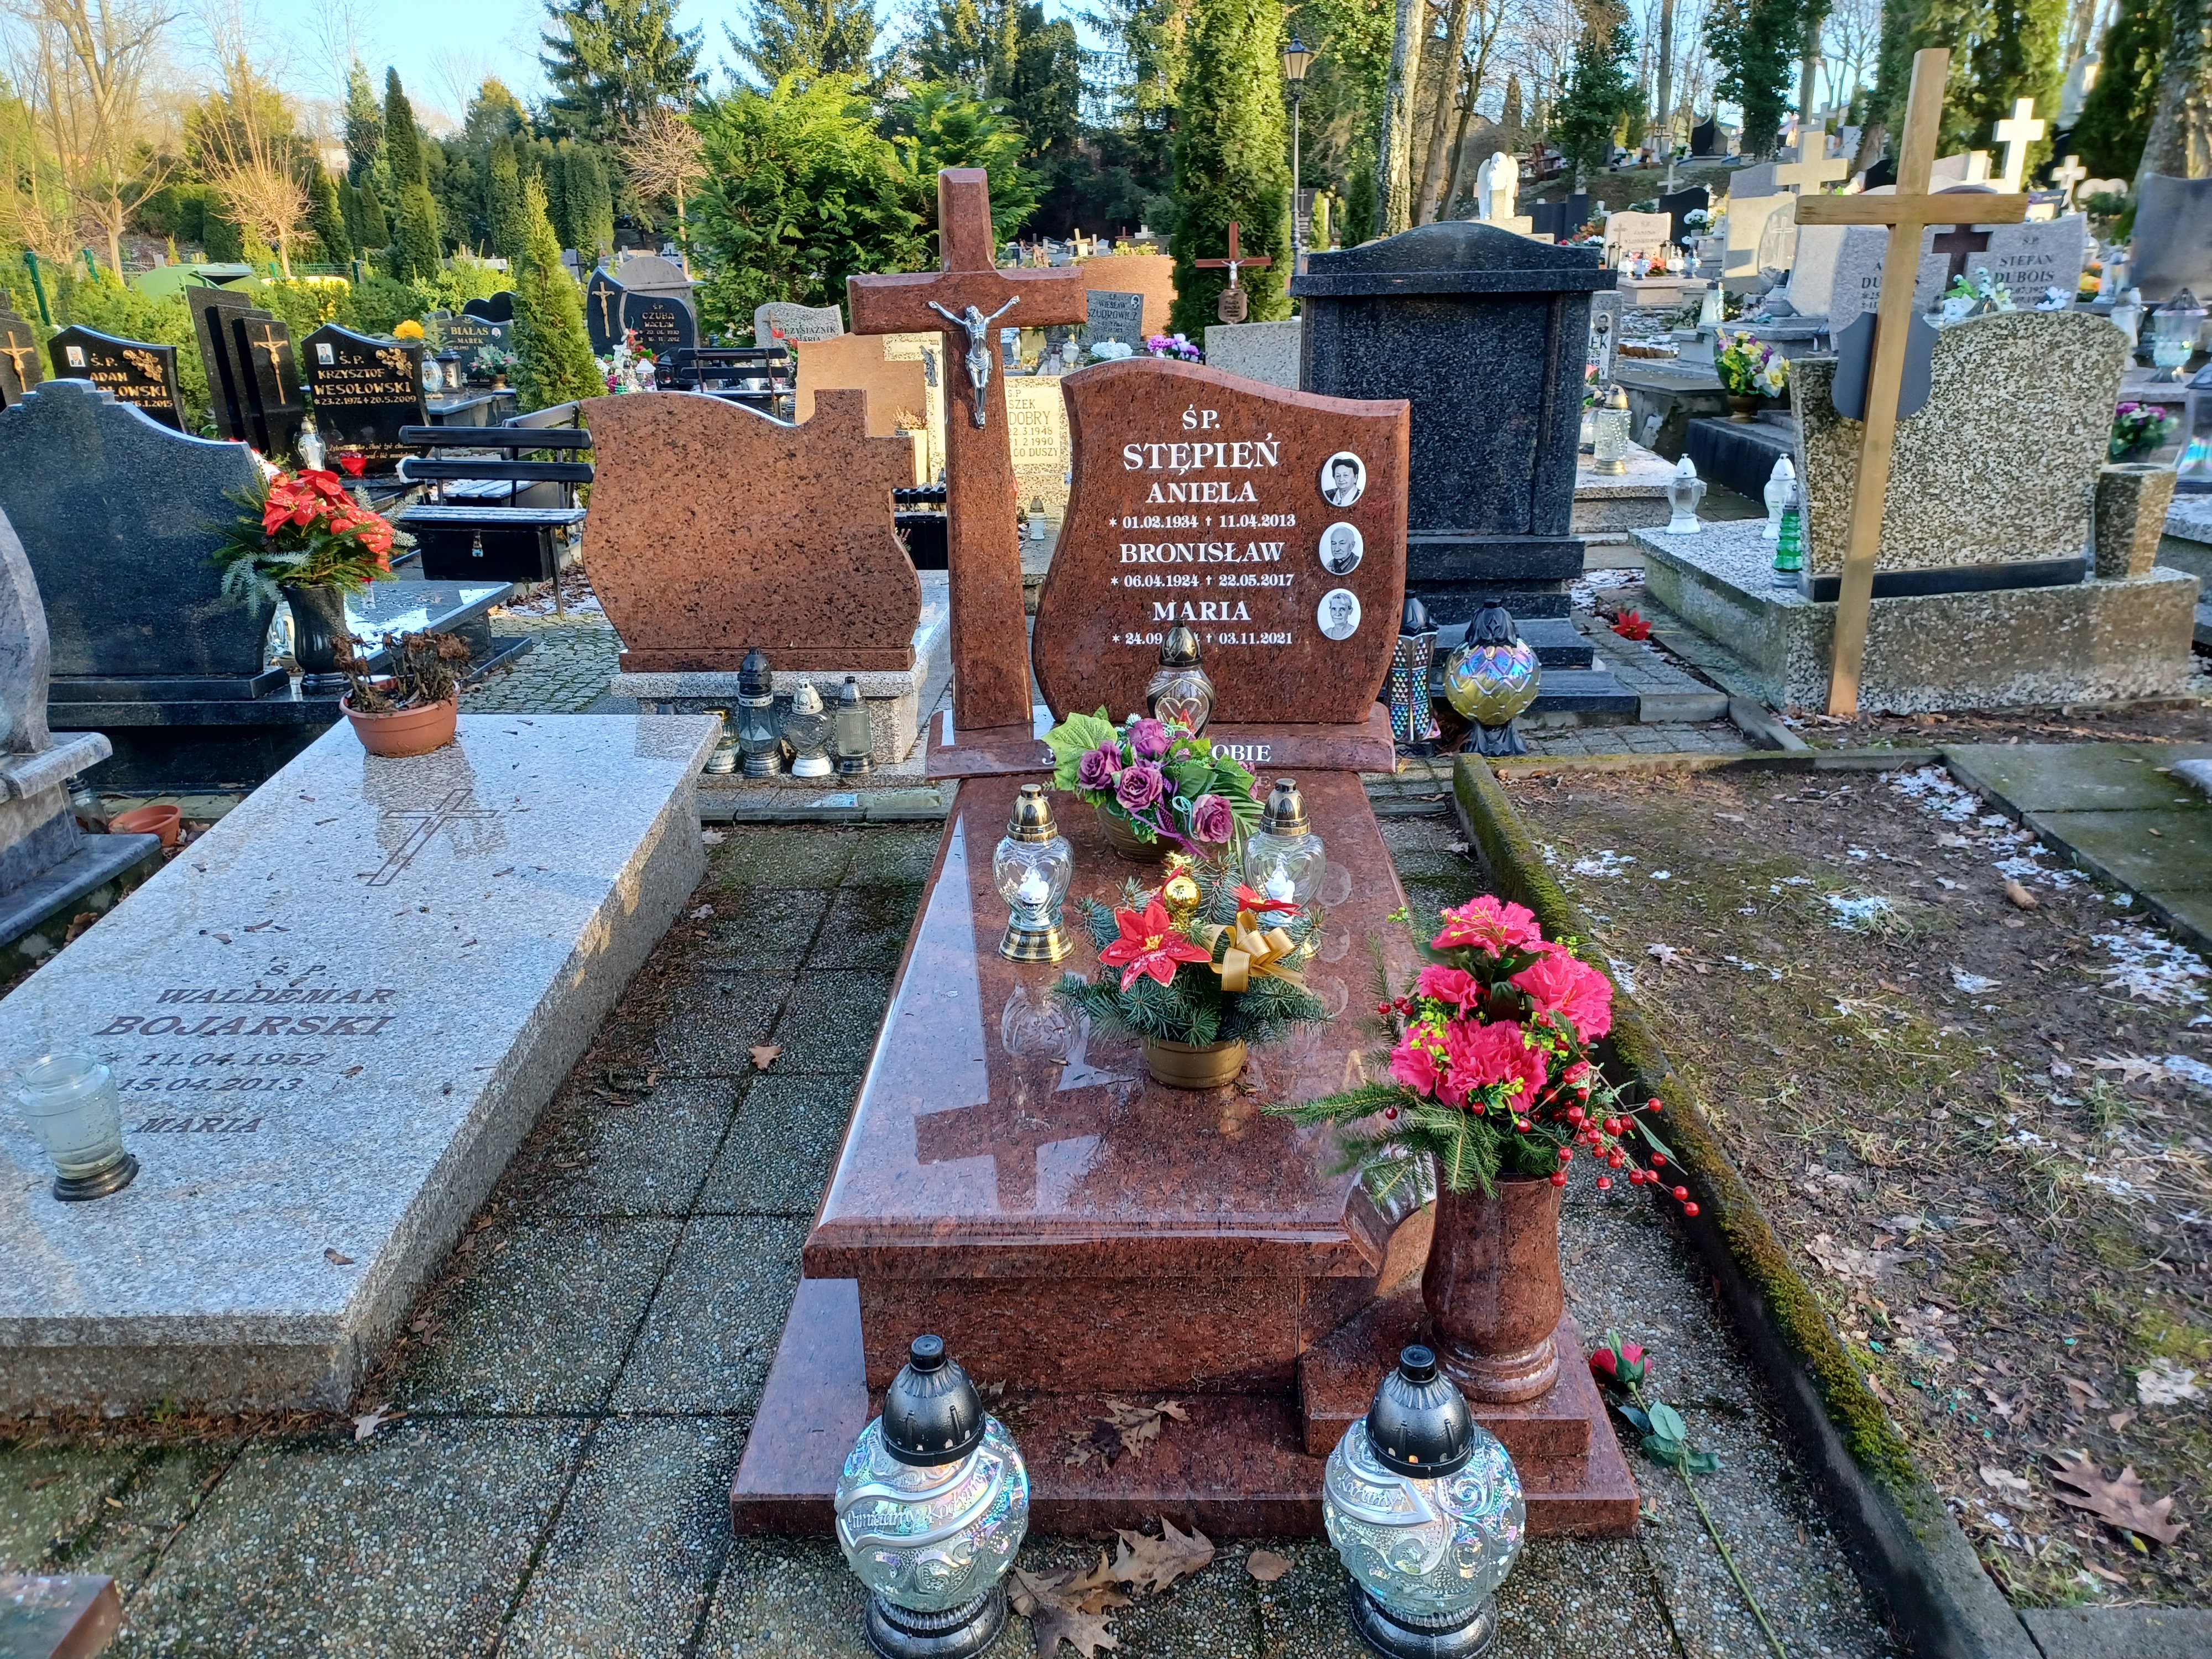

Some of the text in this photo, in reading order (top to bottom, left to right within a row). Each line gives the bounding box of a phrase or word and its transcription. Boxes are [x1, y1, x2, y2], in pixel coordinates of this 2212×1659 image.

[1999, 254, 2052, 267] STEFAN
[1994, 270, 2055, 284] DUBOIS
[450, 326, 489, 336] BIAŁAS
[90, 372, 128, 382] ADAM
[317, 368, 385, 379] KRZYSZTOF
[314, 382, 411, 395] WESOŁOWSKI
[370, 395, 416, 404] 20.5.2009
[1009, 399, 1036, 409] SZEK
[1009, 411, 1050, 425] DOBRY
[1029, 447, 1058, 457] DUSZY
[1123, 432, 1281, 476] STĘPIEŃ
[1145, 480, 1258, 503] ANIELA
[1122, 514, 1296, 529] 01.02.1934 11.04.2013
[1119, 541, 1286, 563] BRONISŁAW
[1124, 573, 1295, 587] 06.04.1924 22.05.2017
[1152, 600, 1252, 621] MARIA
[1219, 632, 1293, 645] 03.11.2021
[1211, 744, 1272, 763] OBIE
[155, 988, 397, 1005] WALDEMAR
[92, 1016, 398, 1036] BOJARSKI
[138, 1052, 327, 1066] 11.04.1952
[117, 1078, 304, 1092] 15.04.2013
[132, 1117, 263, 1134] MARIA
